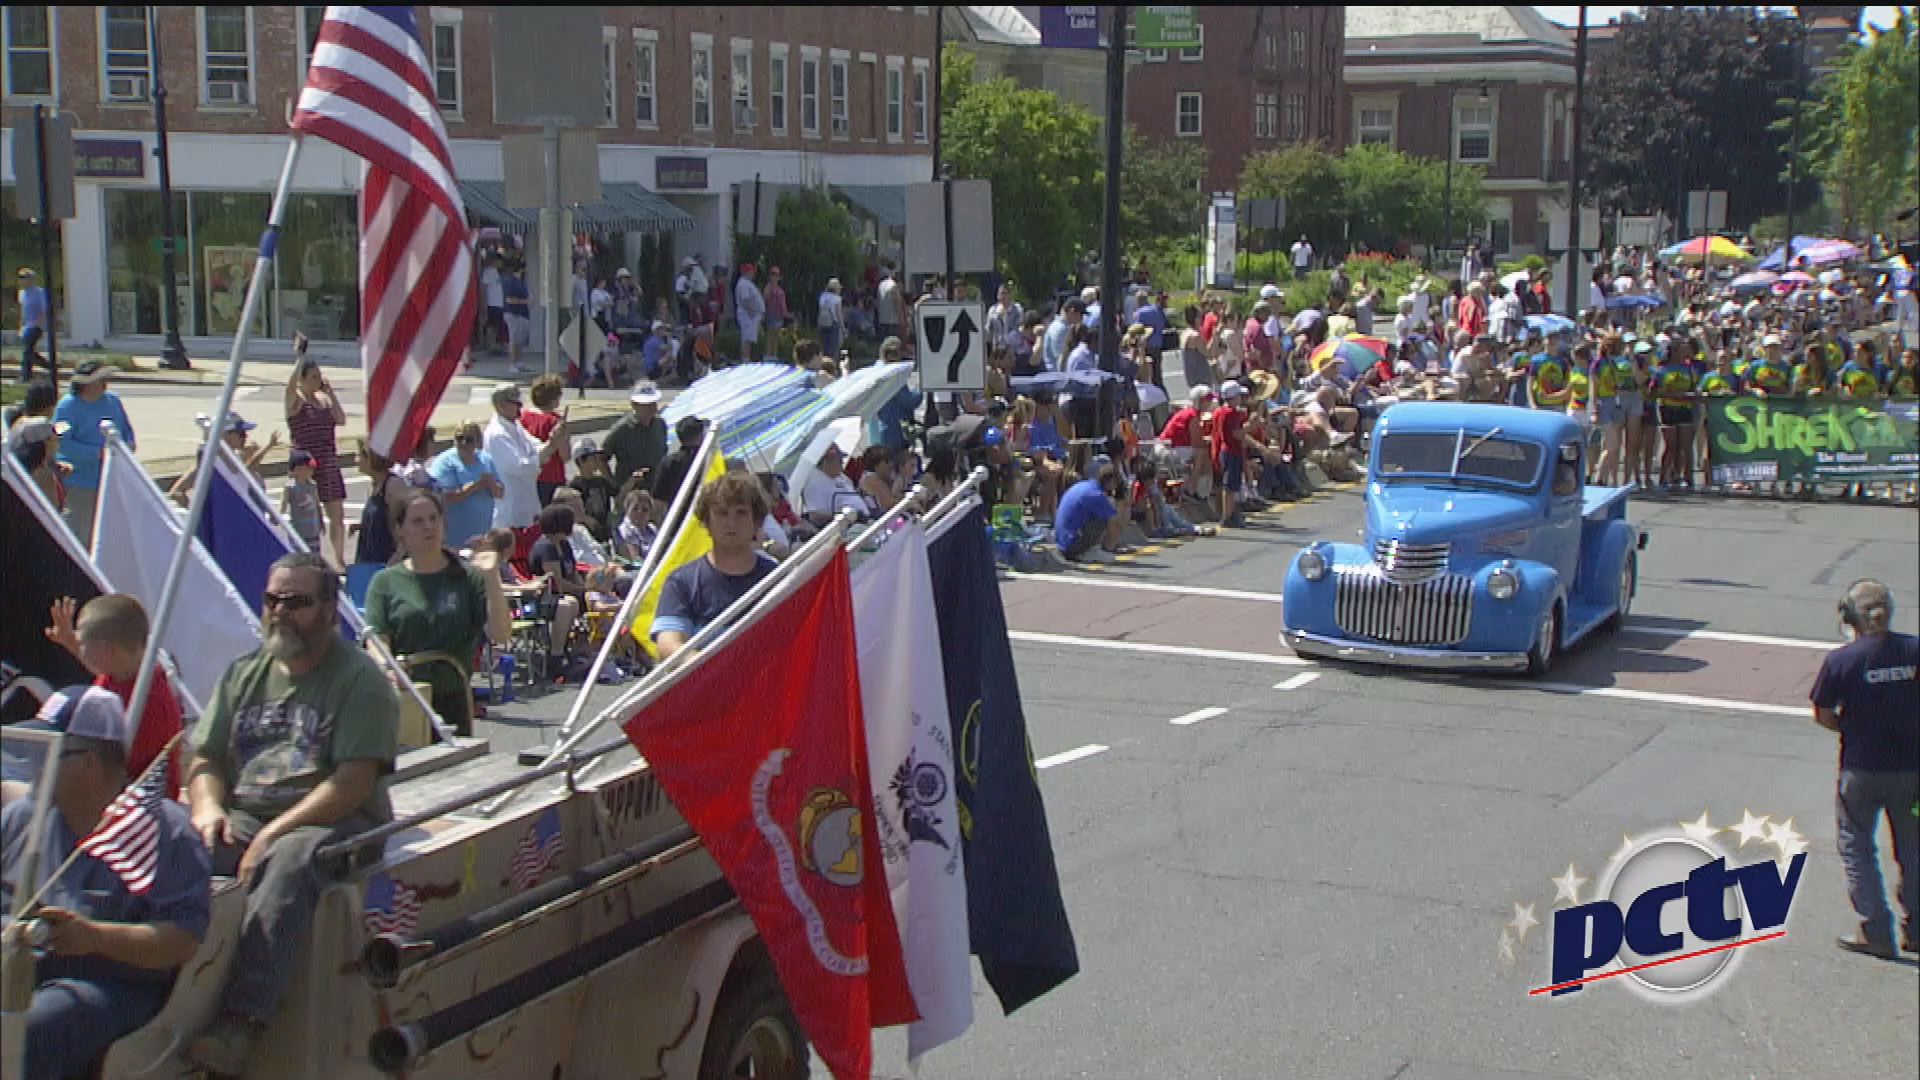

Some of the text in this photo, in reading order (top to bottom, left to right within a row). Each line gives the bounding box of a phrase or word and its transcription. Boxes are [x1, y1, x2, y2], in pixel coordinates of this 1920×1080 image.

[1070, 15, 1096, 28] Lake
[1717, 398, 1857, 456] SHREK
[1865, 665, 1917, 684] CREW
